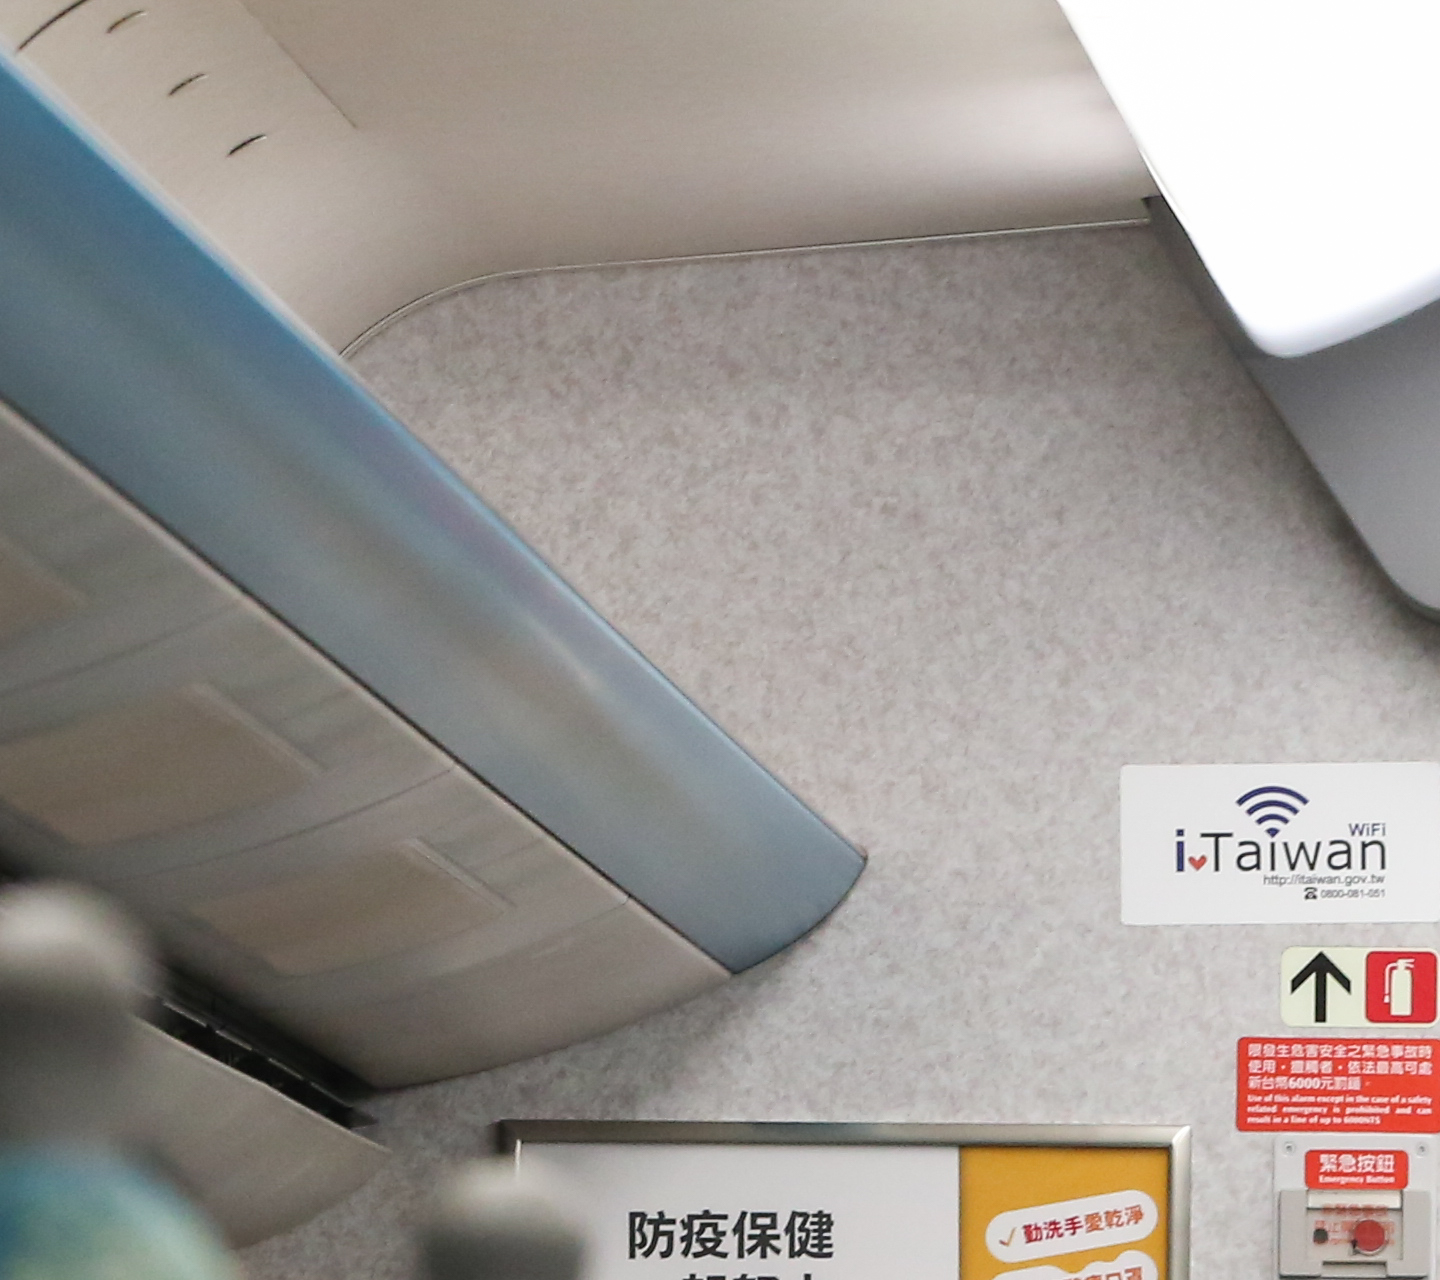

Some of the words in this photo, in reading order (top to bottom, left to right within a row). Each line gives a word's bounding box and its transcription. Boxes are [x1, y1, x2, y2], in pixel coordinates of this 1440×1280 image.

[1349, 823, 1387, 837] WiFi
[1263, 873, 1386, 887] http://itaiwan.gov.tw
[1319, 1153, 1395, 1173] 緊急按鈕
[1319, 1174, 1364, 1185] Emergency
[1366, 1174, 1395, 1184] Button
[1022, 1204, 1145, 1244] 勤洗手愛乾淨
[627, 1209, 835, 1260] 防疫保健
